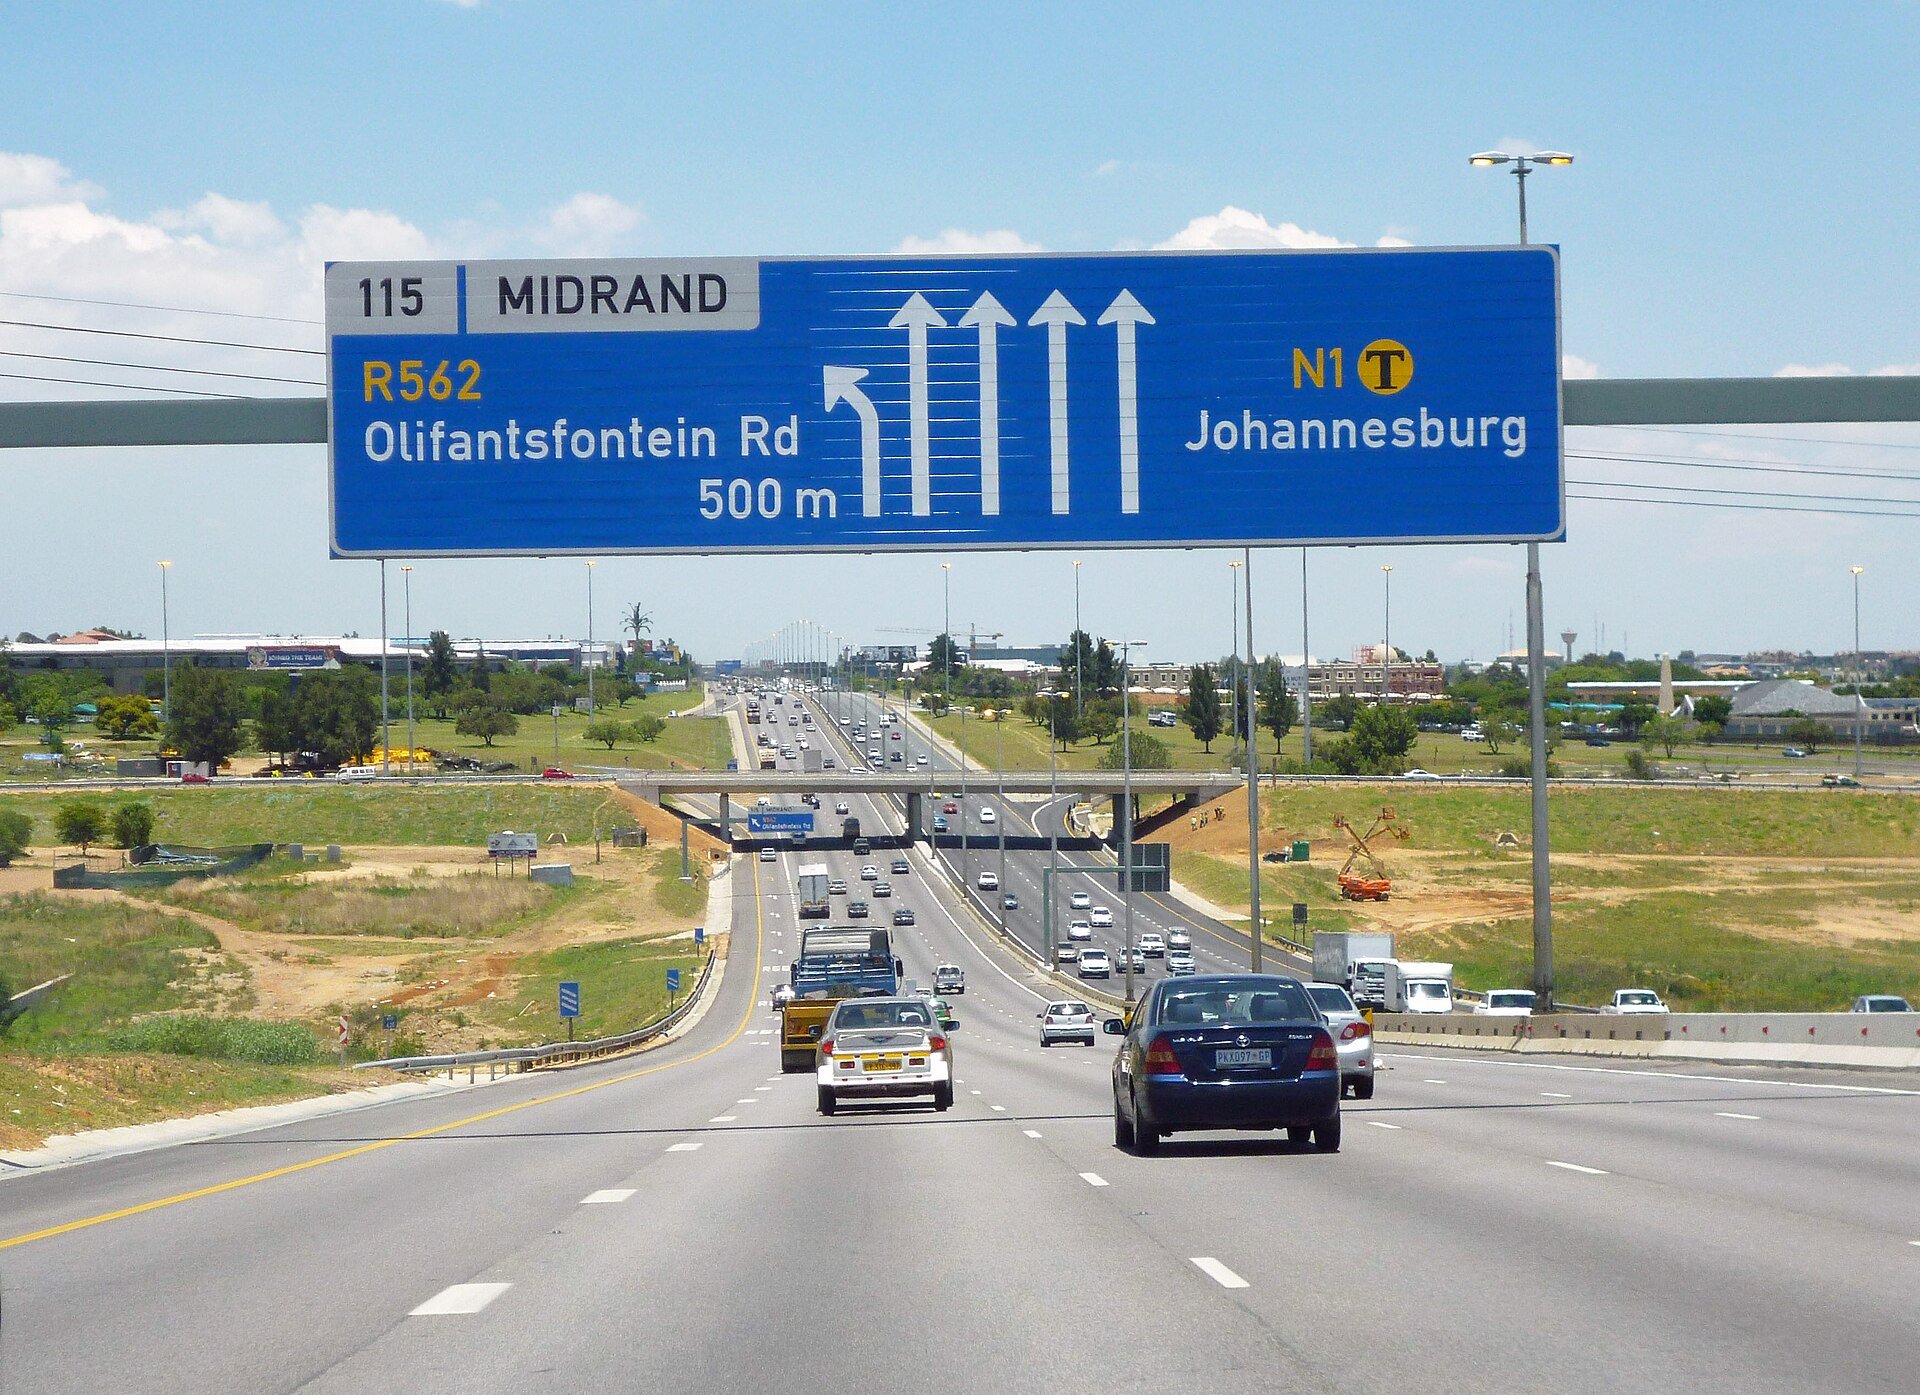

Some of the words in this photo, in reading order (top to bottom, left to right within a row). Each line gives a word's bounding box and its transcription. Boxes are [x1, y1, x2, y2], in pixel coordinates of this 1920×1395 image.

[360, 278, 423, 317] 115
[499, 274, 727, 315] MIDRAND
[364, 360, 481, 401] R562
[1294, 348, 1343, 388] N1
[1366, 350, 1405, 389] T
[365, 417, 716, 461] Olifantsfontein
[741, 415, 798, 456] Rd
[1185, 407, 1526, 457] Johannesburg
[700, 478, 781, 519] 500
[797, 488, 837, 518] m
[1259, 1050, 1270, 1061] GP
